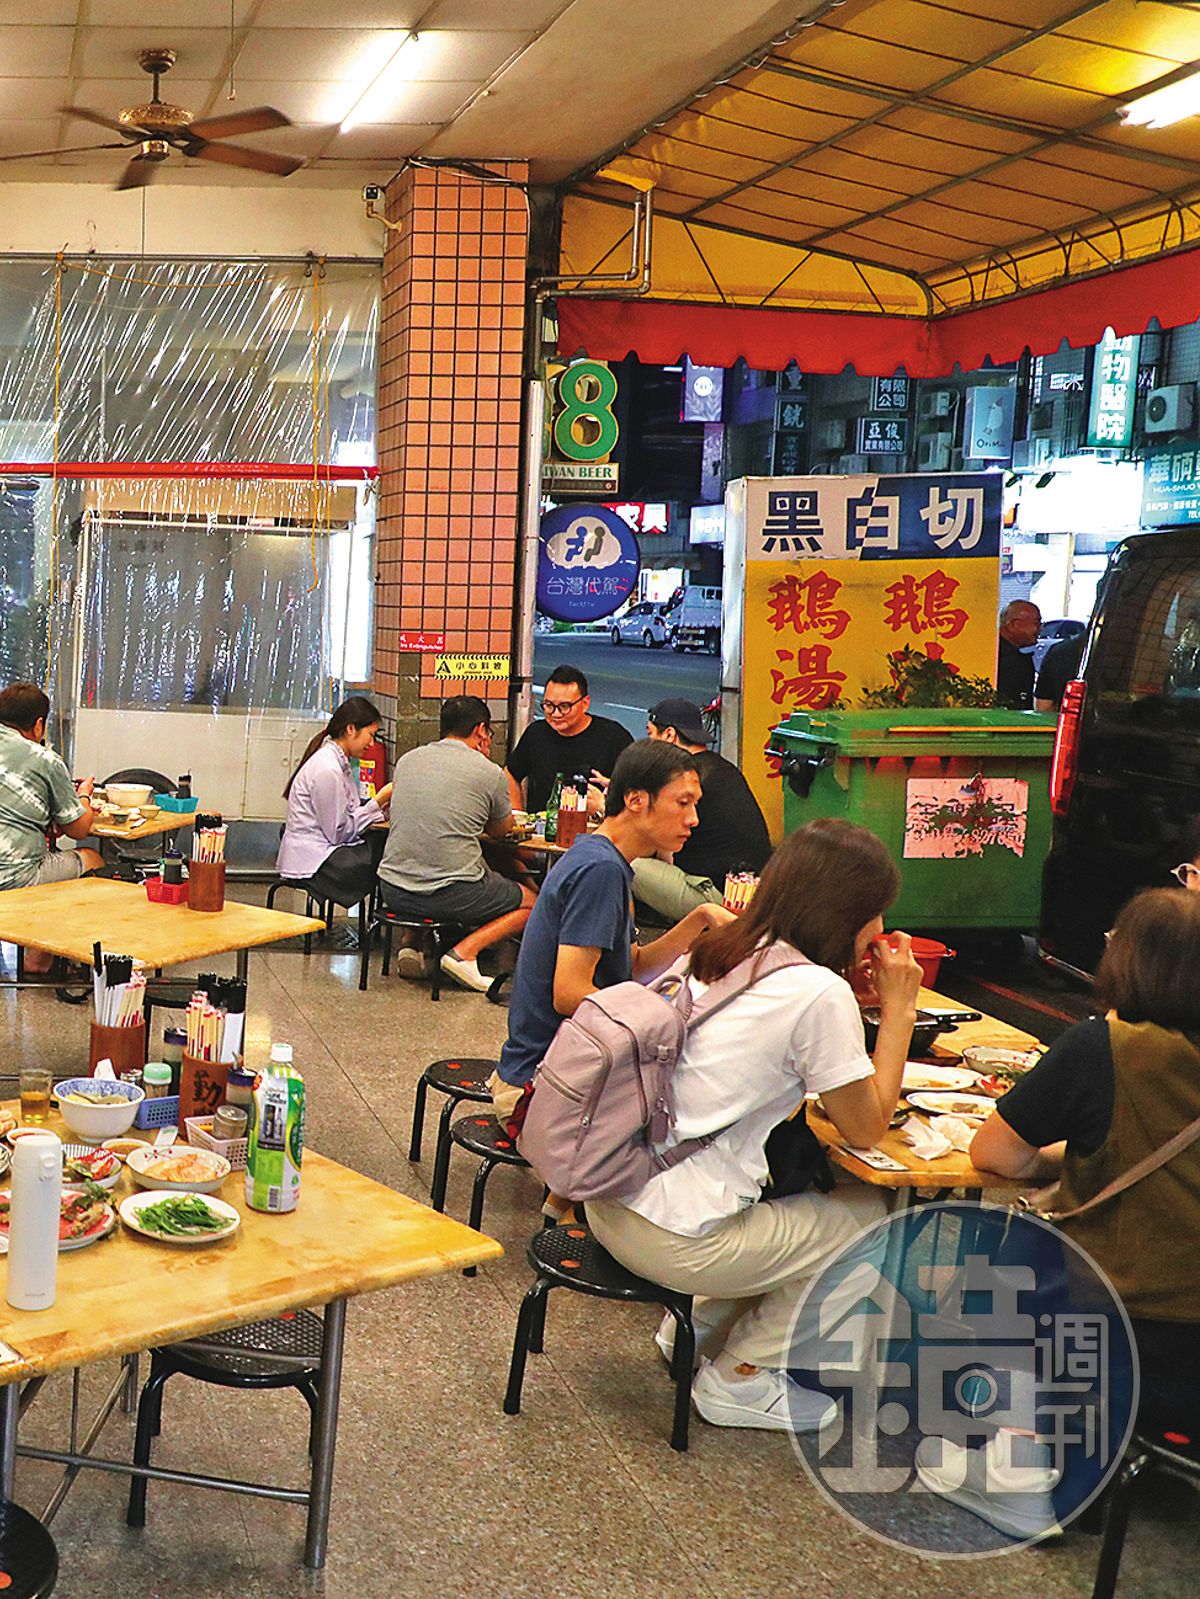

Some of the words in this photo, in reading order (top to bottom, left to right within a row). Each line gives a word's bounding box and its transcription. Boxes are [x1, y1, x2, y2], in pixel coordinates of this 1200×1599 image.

[543, 467, 575, 478] IWAN
[579, 467, 612, 478] BEER
[761, 487, 985, 553] 黑白切
[546, 576, 620, 596] 台灣代駕
